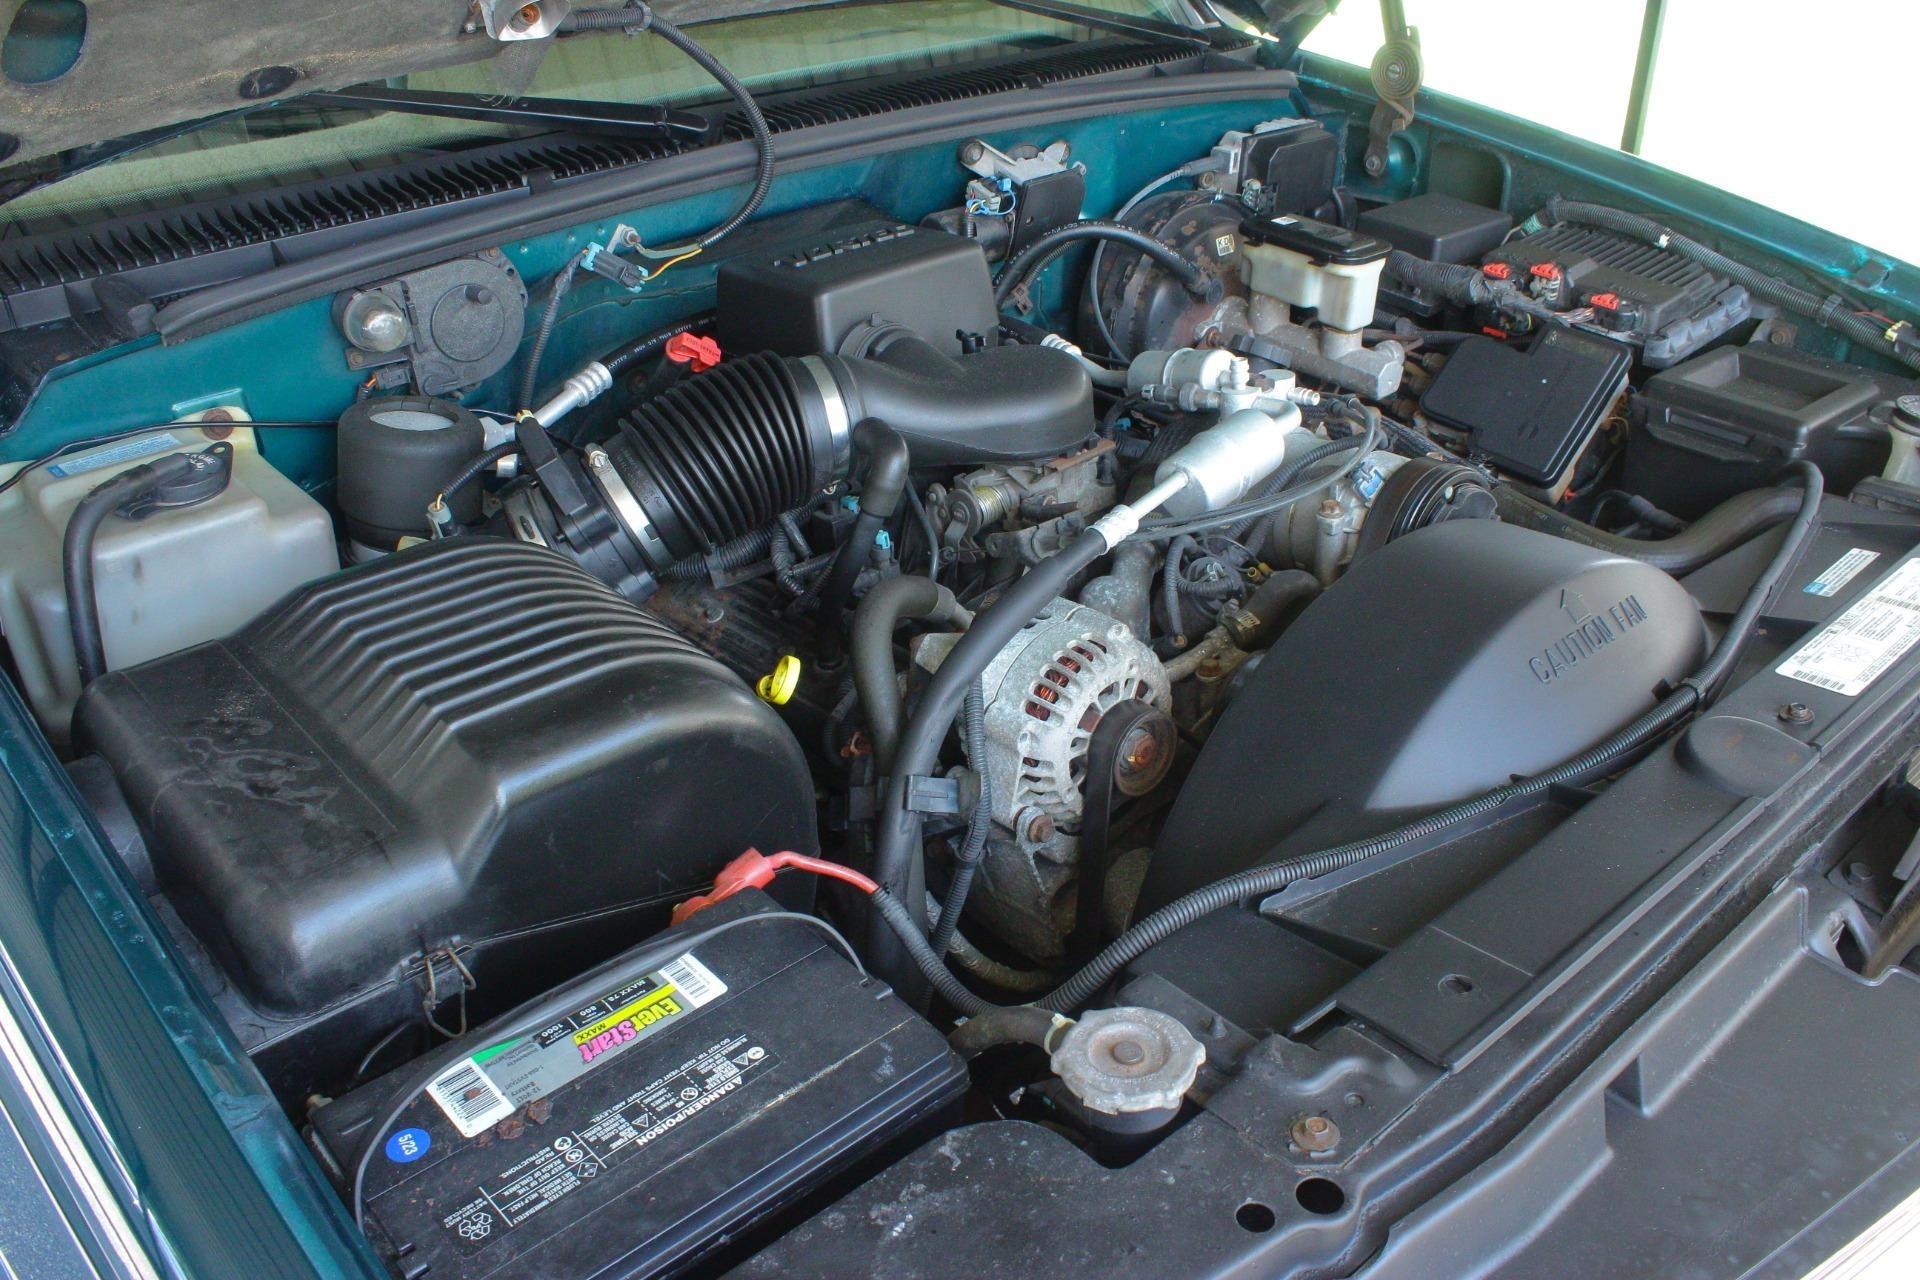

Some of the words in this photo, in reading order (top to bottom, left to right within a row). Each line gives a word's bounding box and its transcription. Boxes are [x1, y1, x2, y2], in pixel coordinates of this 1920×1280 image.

[1529, 619, 1617, 685] CAUTION
[1607, 594, 1648, 637] FAN
[618, 977, 646, 997] MAXX
[578, 1003, 596, 1017] 800
[540, 1021, 563, 1038] 1000
[577, 1021, 606, 1042] MAXX
[580, 996, 682, 1063] EverStart
[707, 1043, 720, 1054] NOT
[719, 1037, 730, 1046] DO
[679, 1057, 696, 1070] KEEP
[662, 1068, 679, 1081] VENT
[644, 1077, 663, 1091] CAPS
[625, 1088, 645, 1103] TIGHT
[610, 1100, 626, 1112] AND
[636, 1083, 736, 1147] DANGER/POISON
[396, 1132, 419, 1157] 5/23
[534, 1150, 554, 1165] READ
[540, 1158, 561, 1173] REACH
[549, 1162, 565, 1174] KEEP
[532, 1170, 541, 1178] OF
[537, 1171, 550, 1182] OUT
[560, 1170, 572, 1181] GET
[560, 1174, 577, 1187] WITH
[516, 1184, 529, 1195] THE
[528, 1179, 538, 1188] OF
[537, 1177, 561, 1194] MEDICAL
[561, 1178, 581, 1193] FLUSH
[522, 1191, 538, 1204] HELP
[547, 1190, 563, 1202] EYES
[461, 1199, 487, 1217] BATTERY
